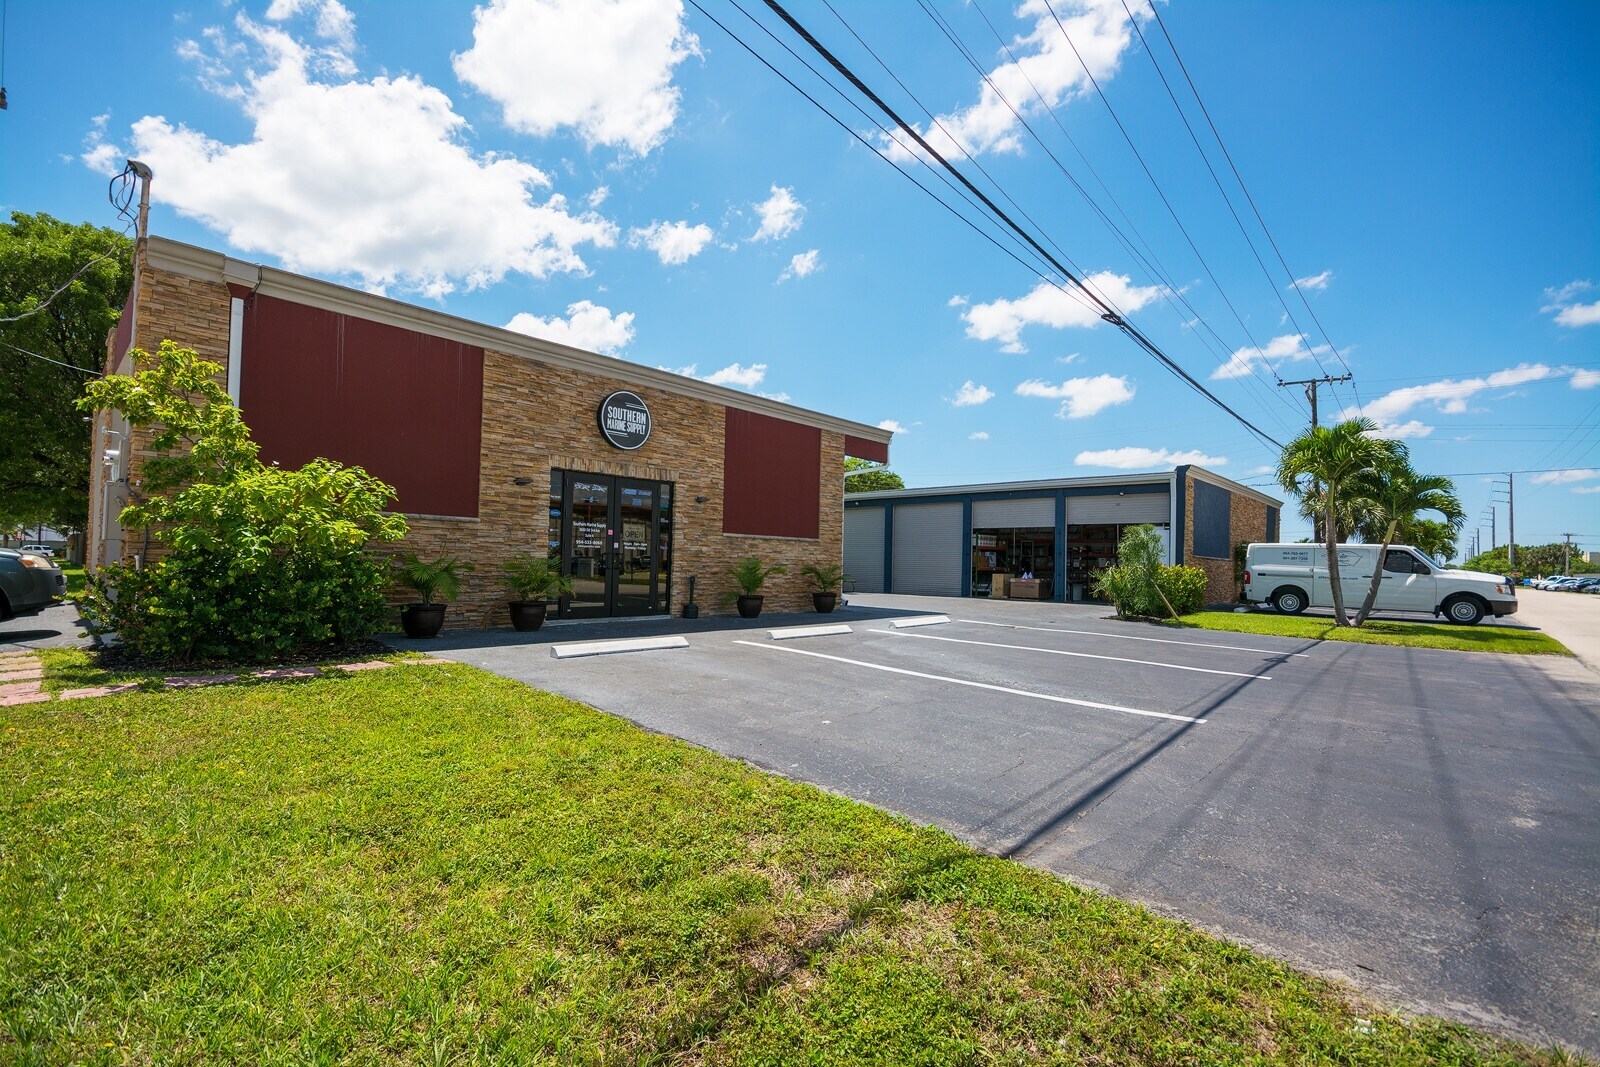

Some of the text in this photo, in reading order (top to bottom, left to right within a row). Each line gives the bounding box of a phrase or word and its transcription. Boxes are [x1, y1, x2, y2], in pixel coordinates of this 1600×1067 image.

[607, 405, 646, 425] SOUTHERN
[606, 417, 646, 435] MARINE SUPPLY
[624, 530, 644, 538] OPEN
